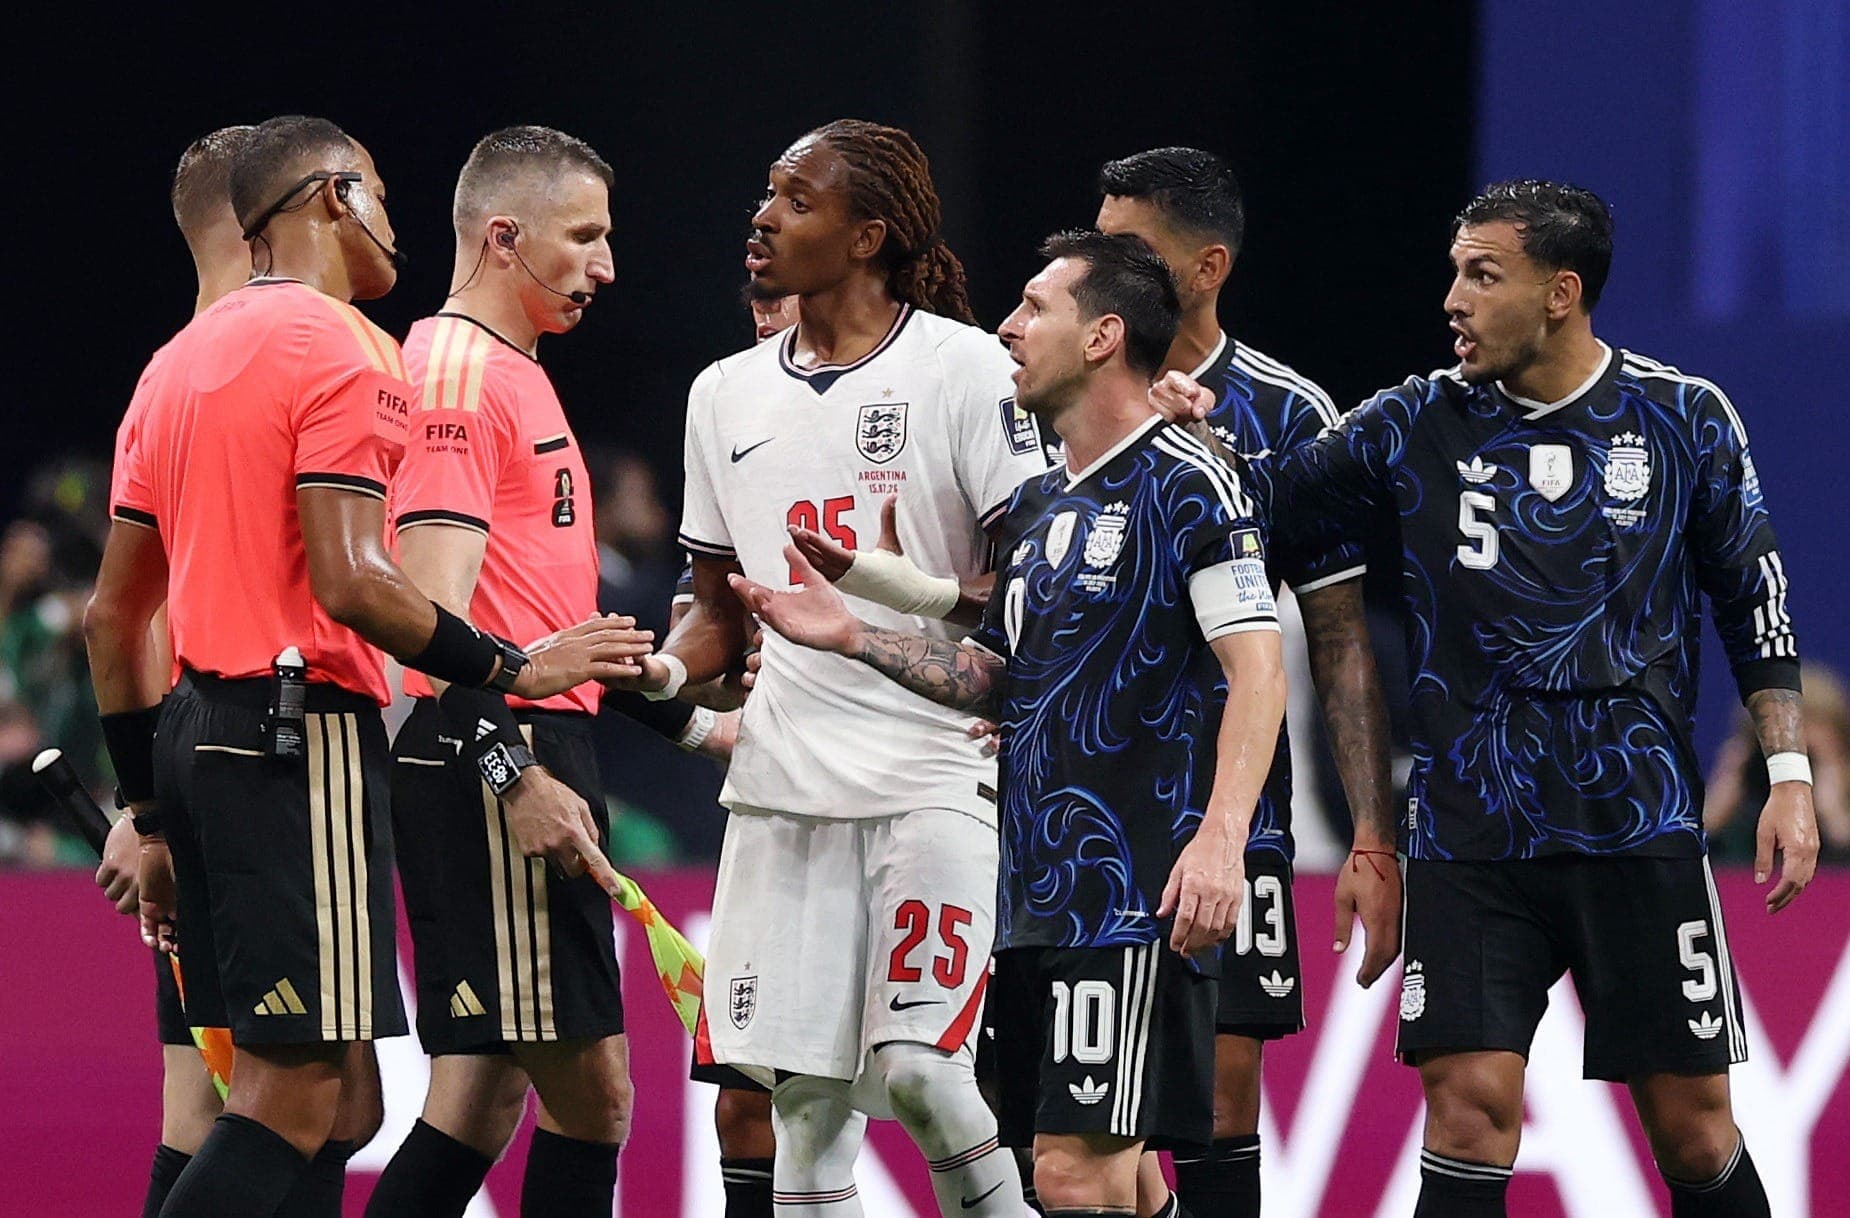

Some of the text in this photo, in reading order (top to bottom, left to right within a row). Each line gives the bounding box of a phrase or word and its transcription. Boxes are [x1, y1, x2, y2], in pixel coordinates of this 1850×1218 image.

[378, 389, 408, 417] FIFA
[426, 424, 468, 442] FIFA
[426, 445, 468, 455] TEAM ONE
[858, 471, 907, 481] ARGENTINA
[1457, 491, 1499, 570] 5
[887, 899, 972, 990] 25
[1235, 875, 1288, 957] 13
[1677, 919, 1718, 1003] 5
[1052, 980, 1117, 1065] 10
